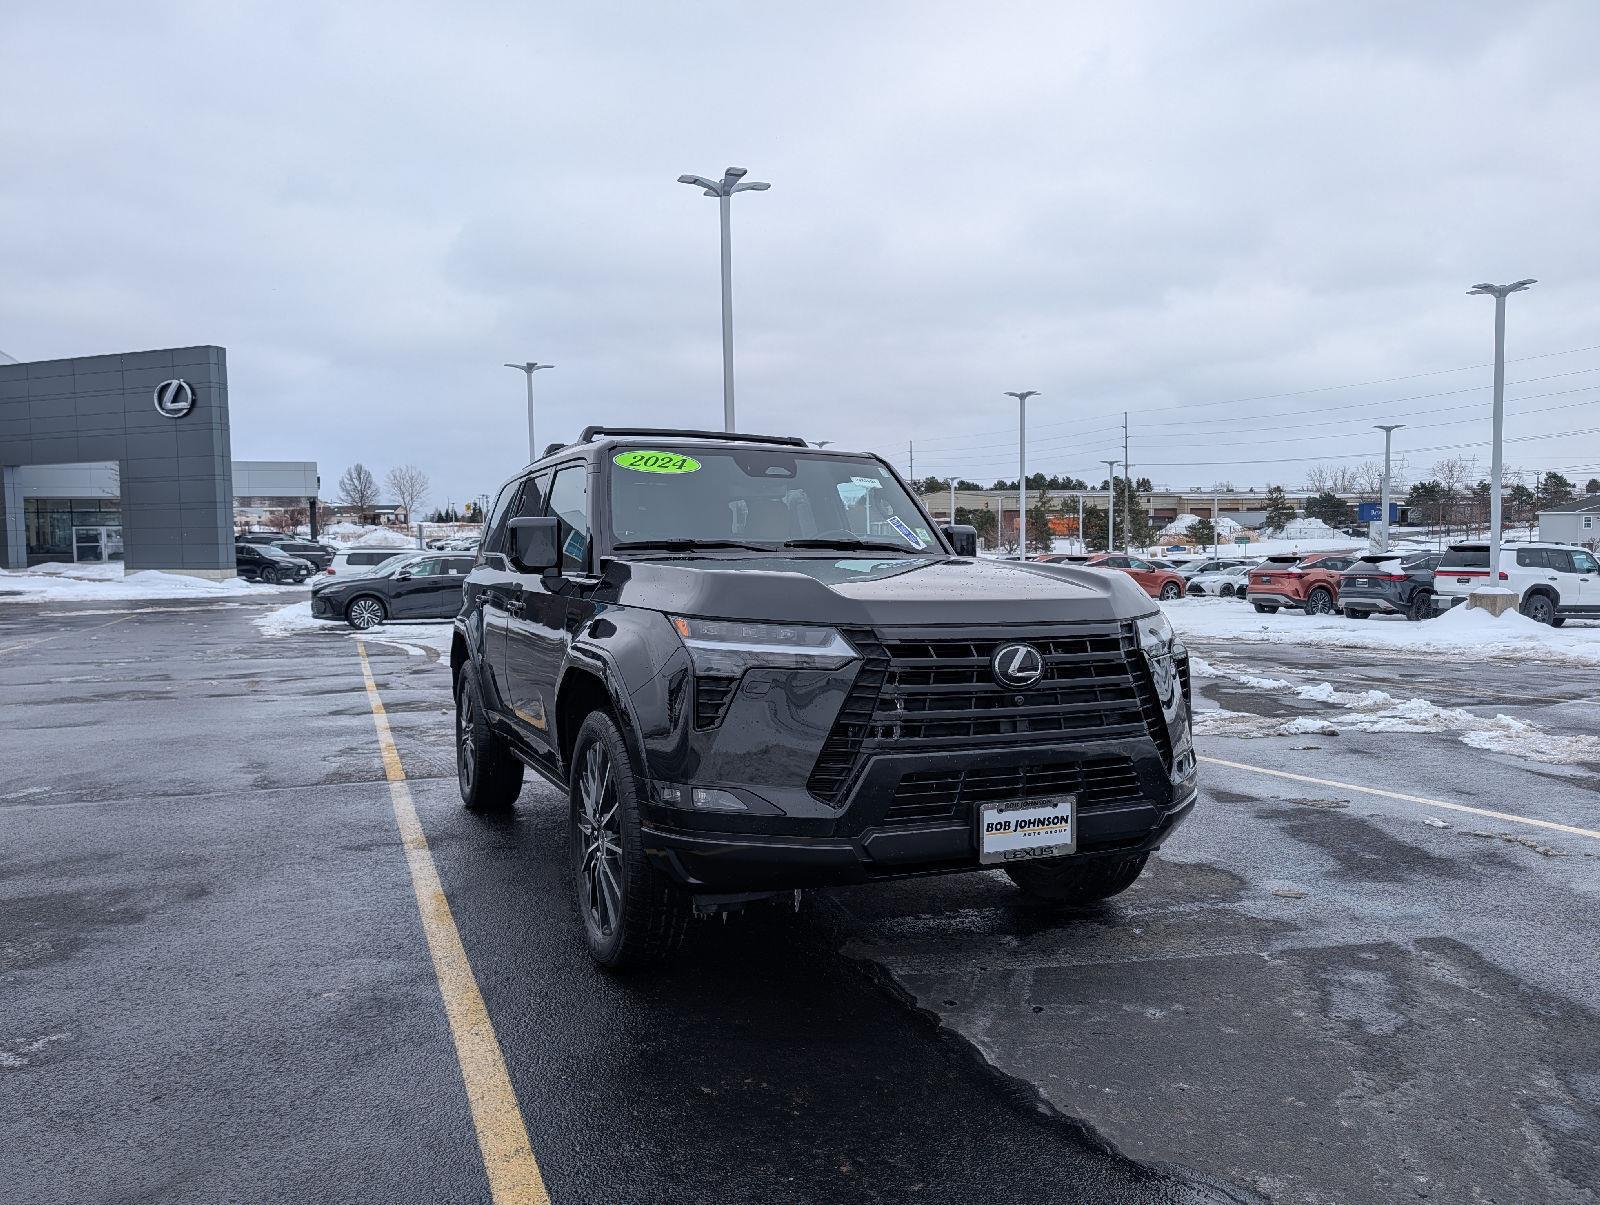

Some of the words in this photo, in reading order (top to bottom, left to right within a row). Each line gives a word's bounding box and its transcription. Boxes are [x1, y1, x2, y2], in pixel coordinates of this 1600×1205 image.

[628, 455, 687, 470] 2024
[986, 821, 1011, 832] BOB
[1013, 815, 1069, 832] JOHNSON
[1004, 847, 1054, 859] LEXUS
